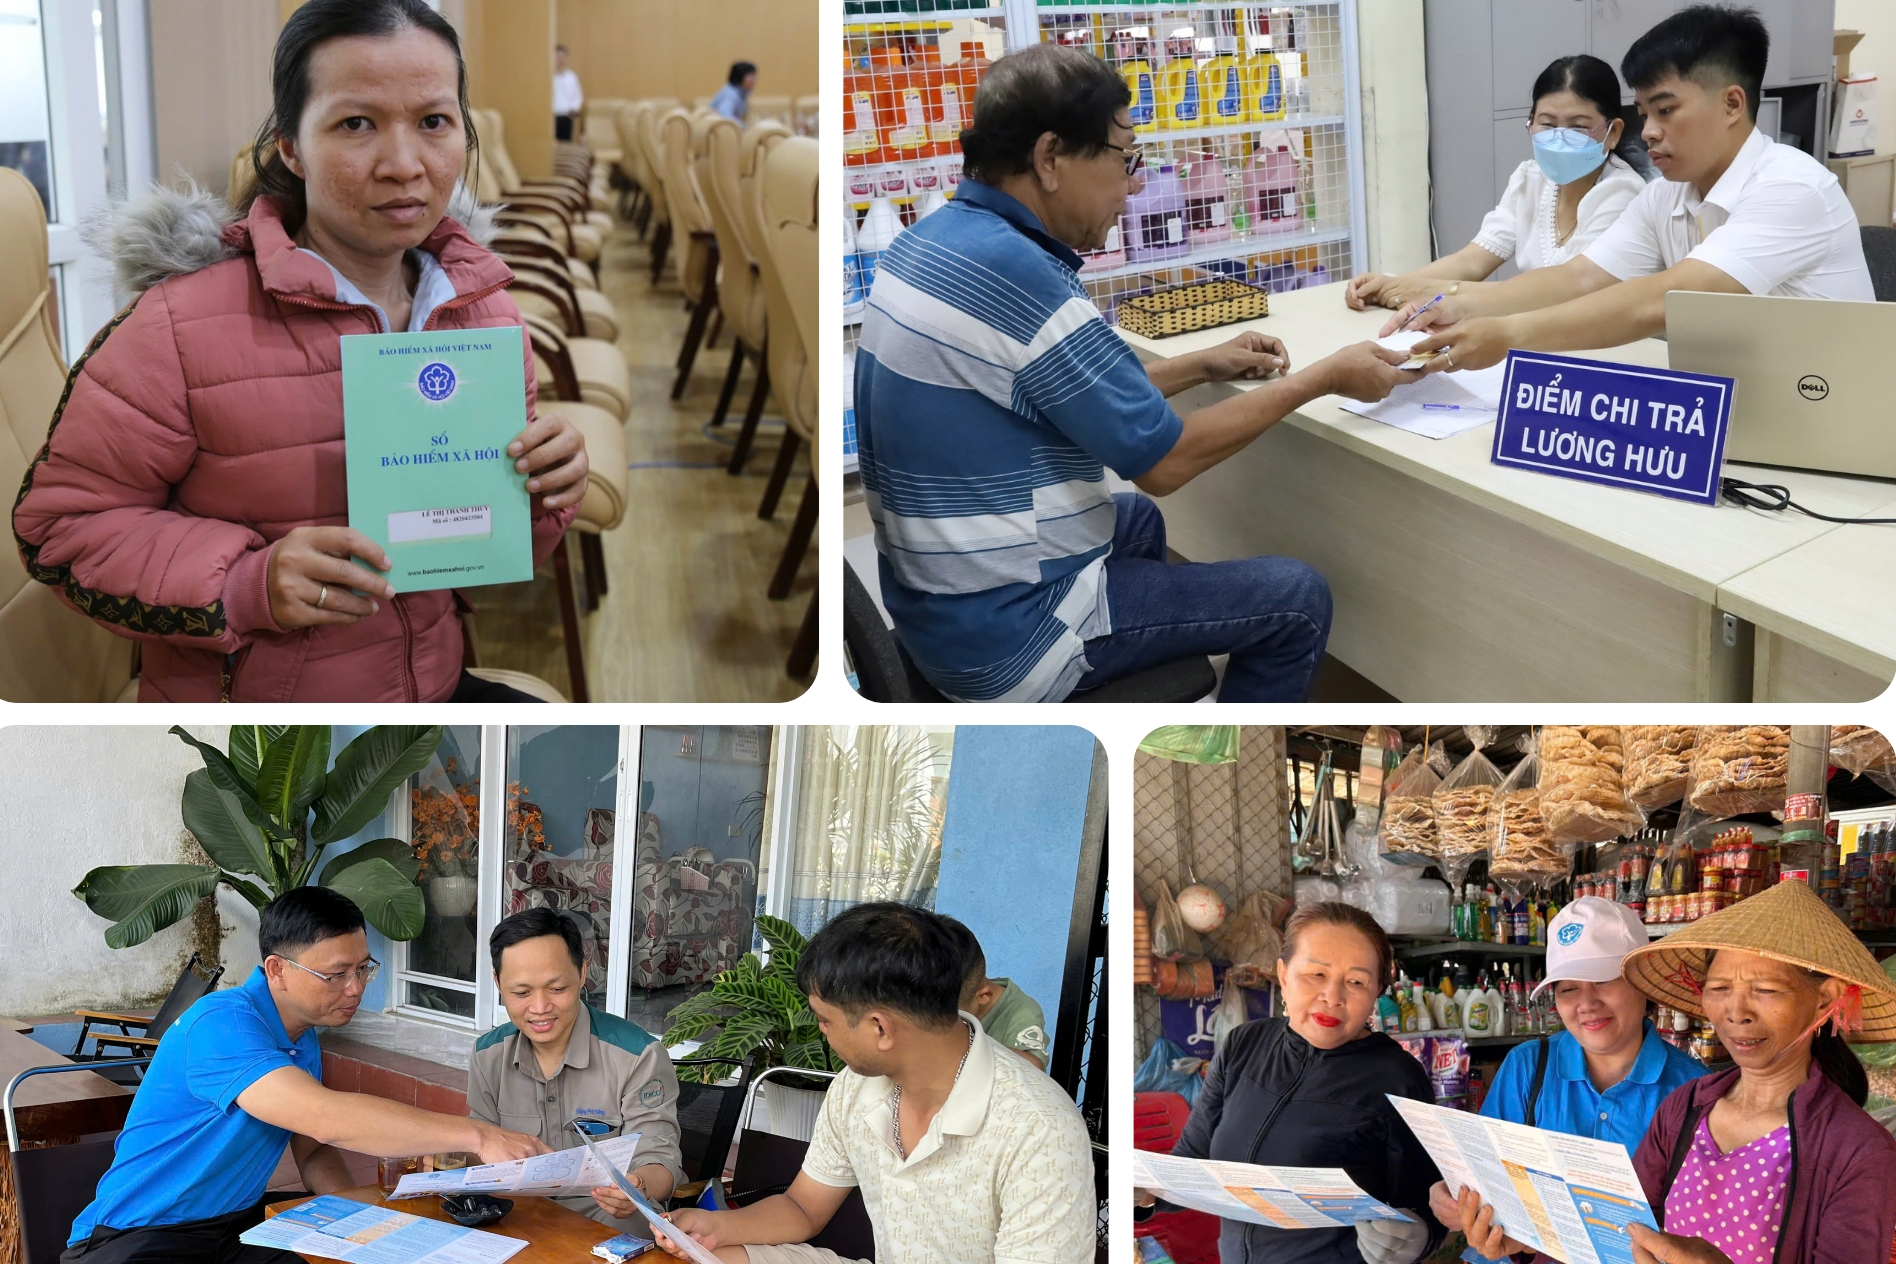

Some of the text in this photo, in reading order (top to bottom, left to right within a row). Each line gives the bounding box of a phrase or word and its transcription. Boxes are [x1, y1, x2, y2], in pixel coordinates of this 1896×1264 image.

[379, 347, 397, 355] BẢO
[398, 345, 420, 355] HIỂM
[422, 346, 434, 354] XÃ
[435, 344, 451, 354] HỘI
[452, 343, 472, 352] VIỆT
[1801, 383, 1826, 392] DELL
[1516, 373, 1582, 417] ĐIỂM
[1590, 393, 1639, 426] CHI
[1647, 396, 1706, 437] TRẢ
[431, 430, 449, 446] SỔ
[381, 447, 499, 467] BẢO HIỂM XÃ HỘI
[1521, 427, 1687, 480] LƯƠNG HƯU
[446, 507, 469, 516] THANH
[407, 564, 485, 577] www.baohiemxahoi.gov.vn
